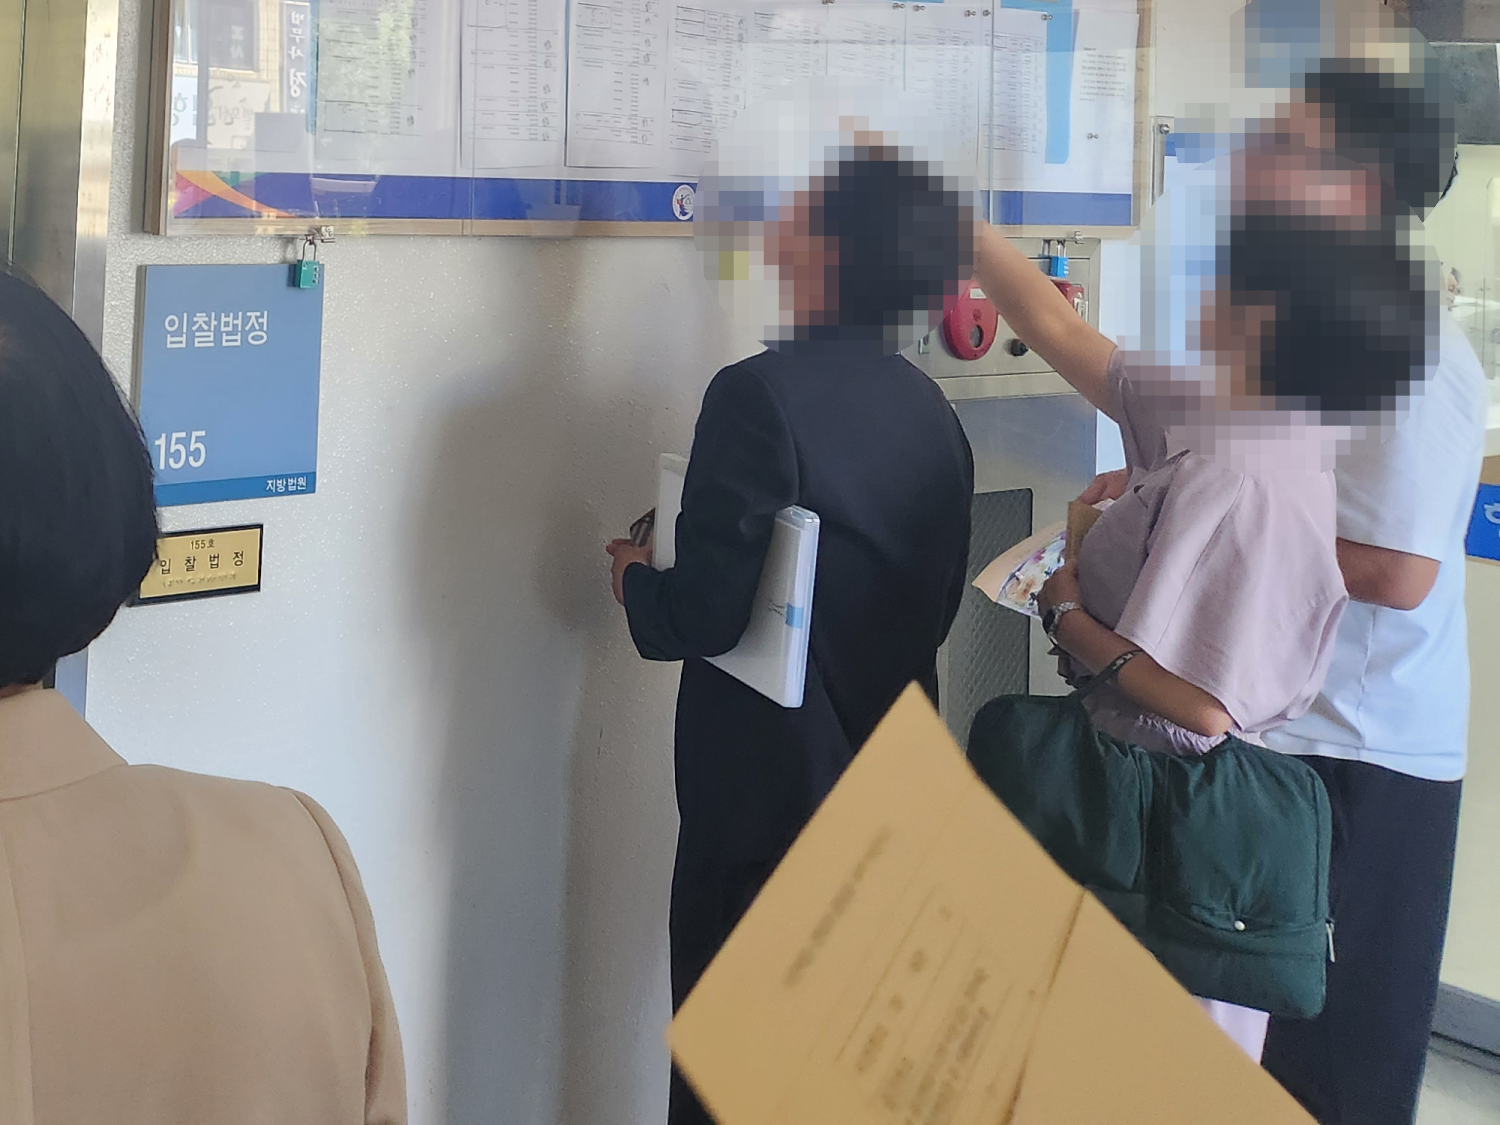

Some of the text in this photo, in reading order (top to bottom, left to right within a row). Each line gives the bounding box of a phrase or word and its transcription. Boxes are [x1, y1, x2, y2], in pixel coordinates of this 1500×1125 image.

[164, 310, 269, 349] 입찰법정
[154, 430, 207, 471] 155
[190, 538, 215, 550] 155호
